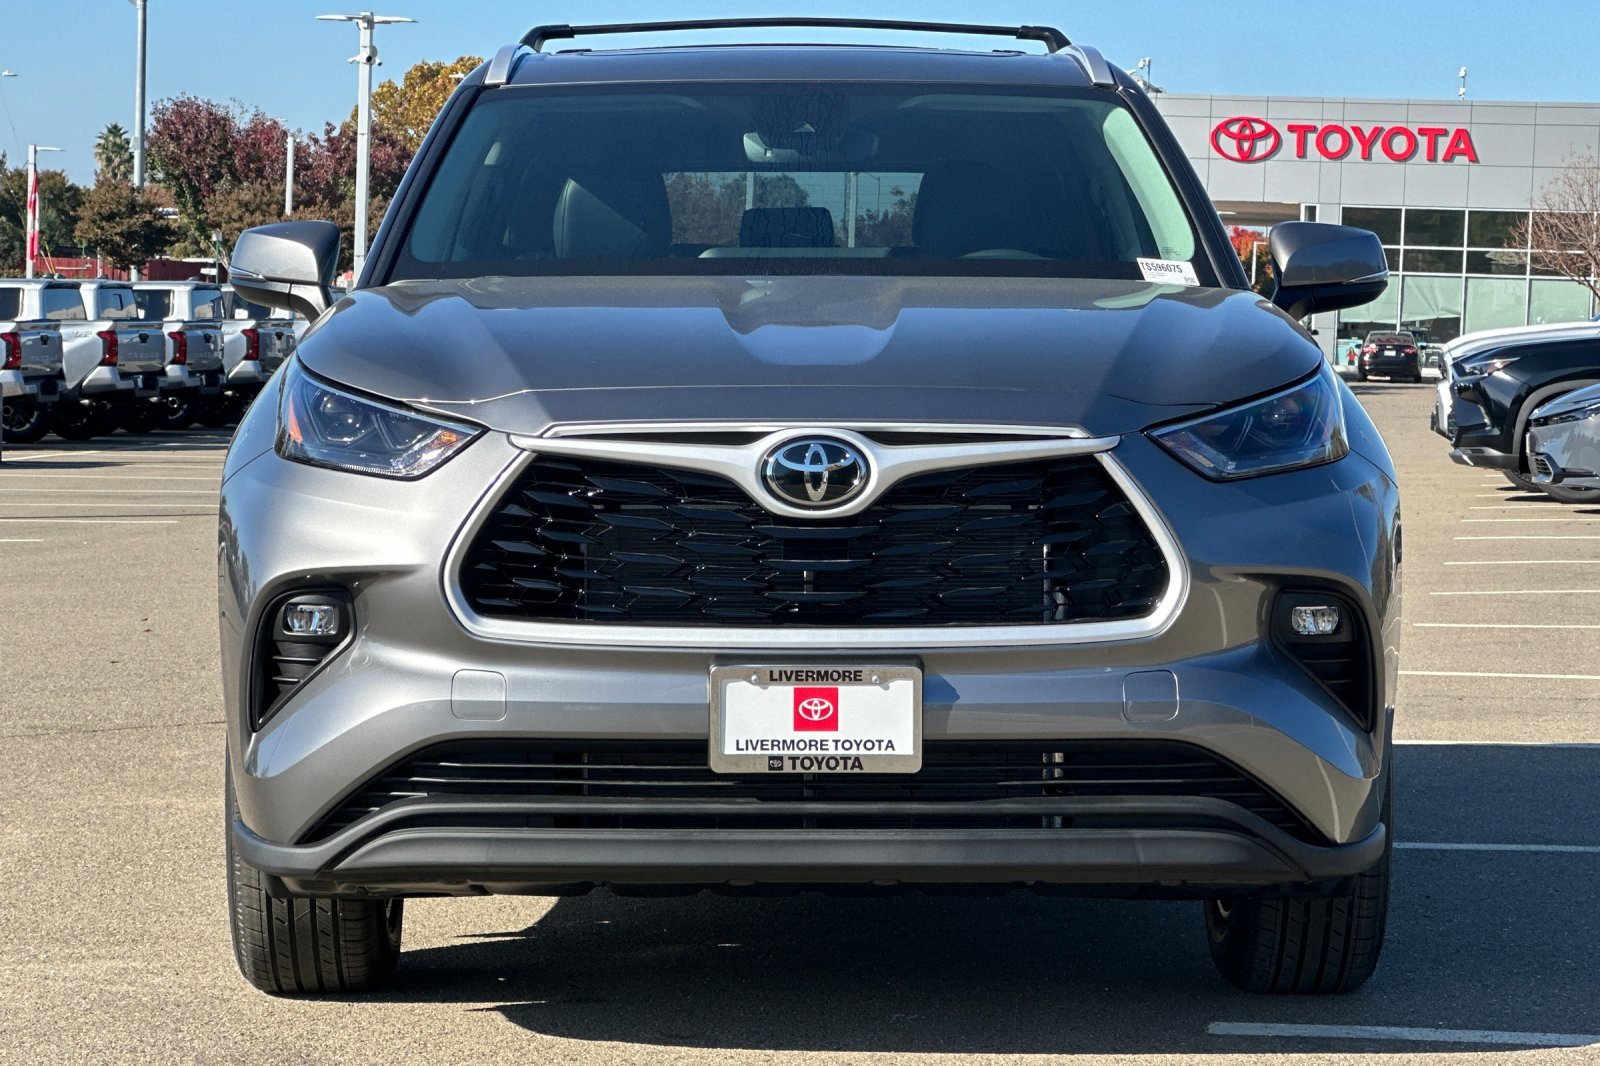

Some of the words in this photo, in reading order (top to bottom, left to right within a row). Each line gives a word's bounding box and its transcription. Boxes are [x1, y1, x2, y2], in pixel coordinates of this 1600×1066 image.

[1287, 124, 1478, 163] TOYOTA
[1140, 262, 1183, 274] TS596075
[769, 670, 863, 682] LIVERMORE
[735, 739, 829, 751] LIVERMORE
[834, 739, 896, 751] TOYOTA
[788, 756, 864, 771] TOYOTA
